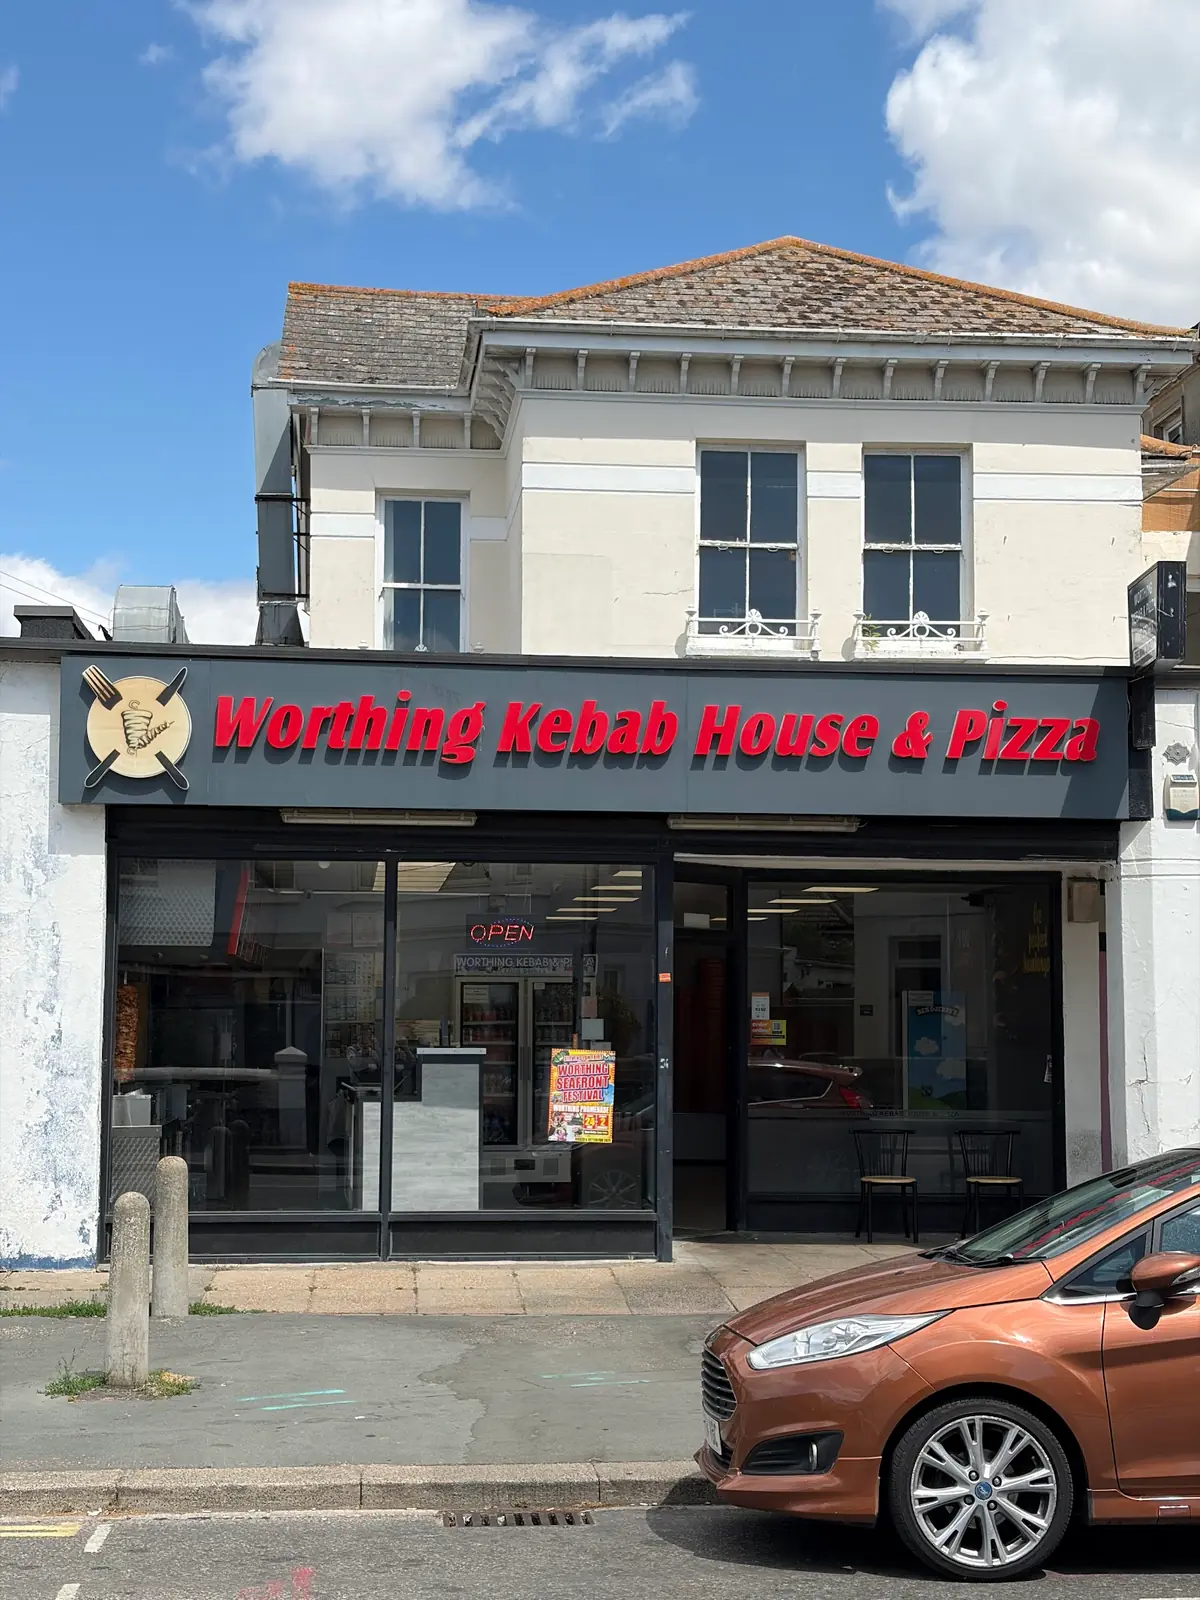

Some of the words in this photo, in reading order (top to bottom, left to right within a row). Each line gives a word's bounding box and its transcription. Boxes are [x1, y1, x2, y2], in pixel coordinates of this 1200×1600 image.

[214, 690, 486, 764] Worthing
[497, 699, 679, 755] Kebab
[694, 704, 879, 757] House
[891, 711, 933, 758] &
[945, 699, 1100, 761] Pizza
[470, 924, 535, 941] OPEN
[456, 957, 512, 967] WORTHING
[516, 957, 549, 967] KEBAB
[558, 1063, 609, 1076] WORTHING
[556, 1075, 609, 1090] SEAFRONT
[562, 1089, 604, 1103] FESTIVAL
